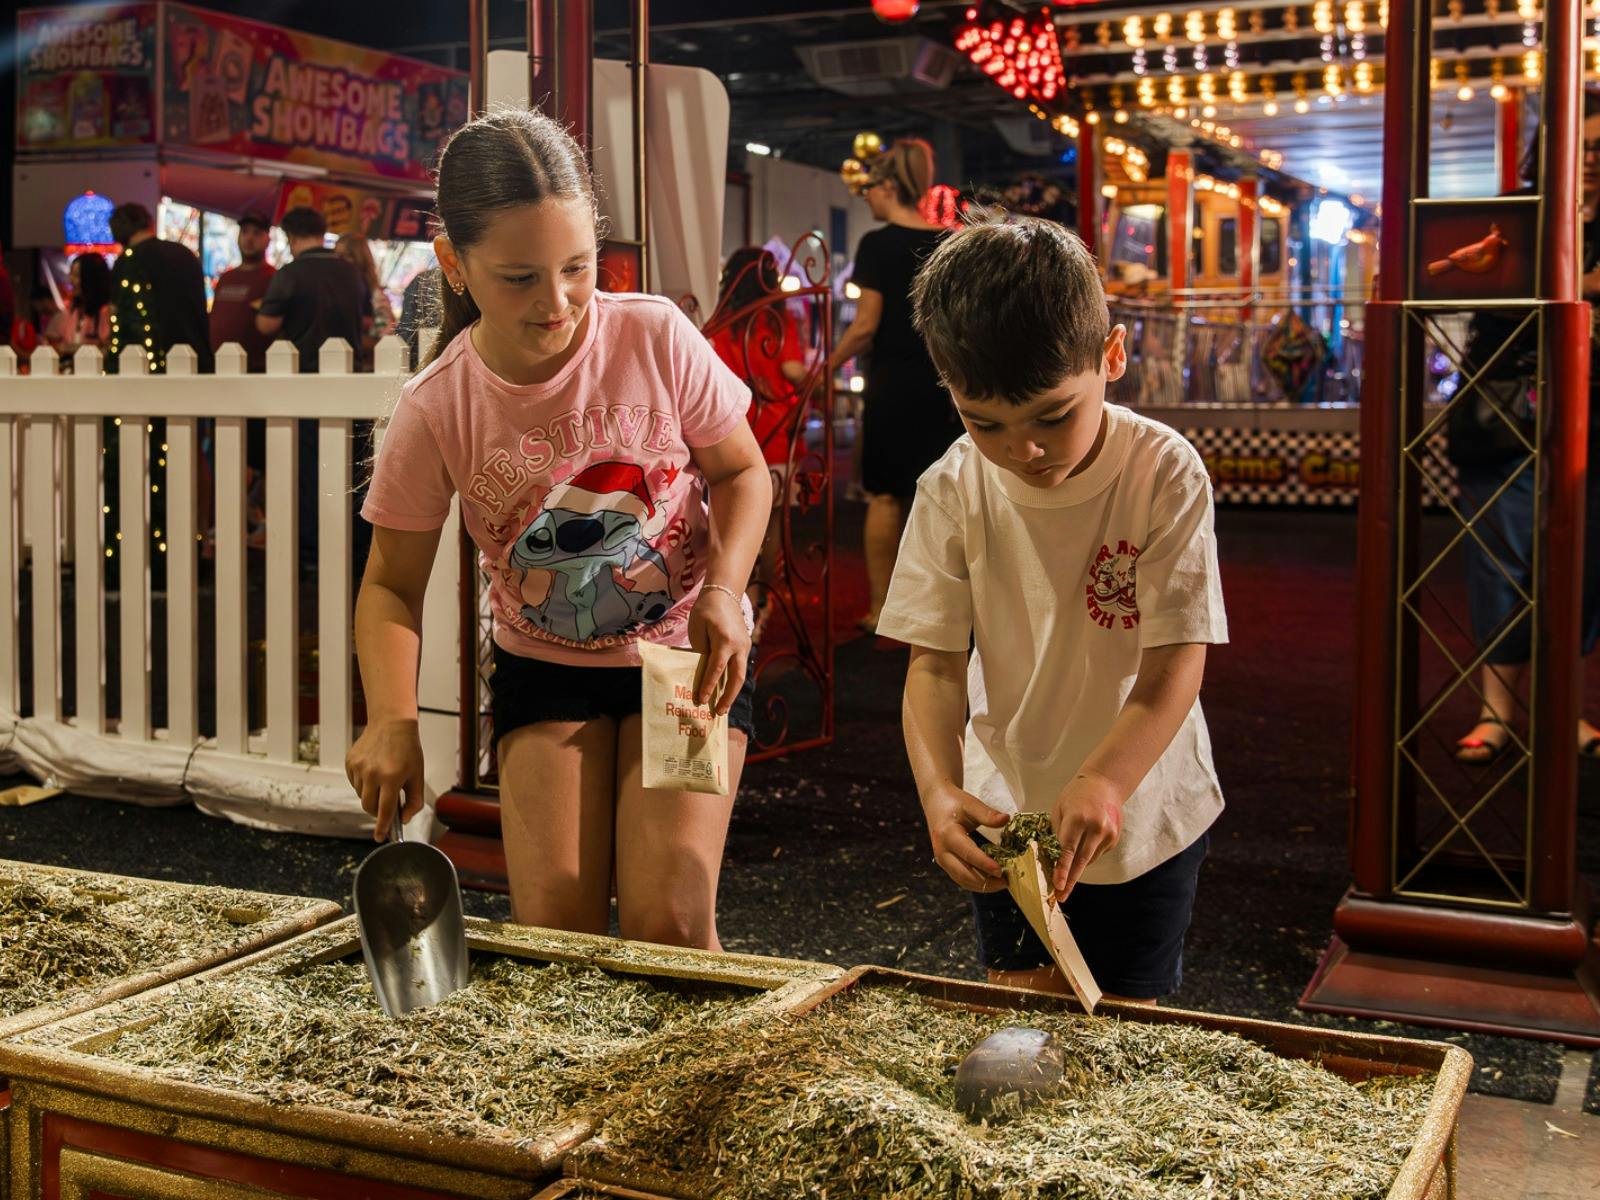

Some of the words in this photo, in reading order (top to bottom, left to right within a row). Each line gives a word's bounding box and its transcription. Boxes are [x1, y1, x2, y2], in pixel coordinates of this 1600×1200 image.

[38, 18, 137, 47] AWESOME
[30, 41, 145, 70] SHOWBAGS
[265, 57, 403, 119] AWESOME
[252, 96, 409, 159] SHOWBAGS
[468, 404, 674, 514] FESTIVE
[665, 702, 715, 720] Reindee
[678, 722, 707, 738] Food
